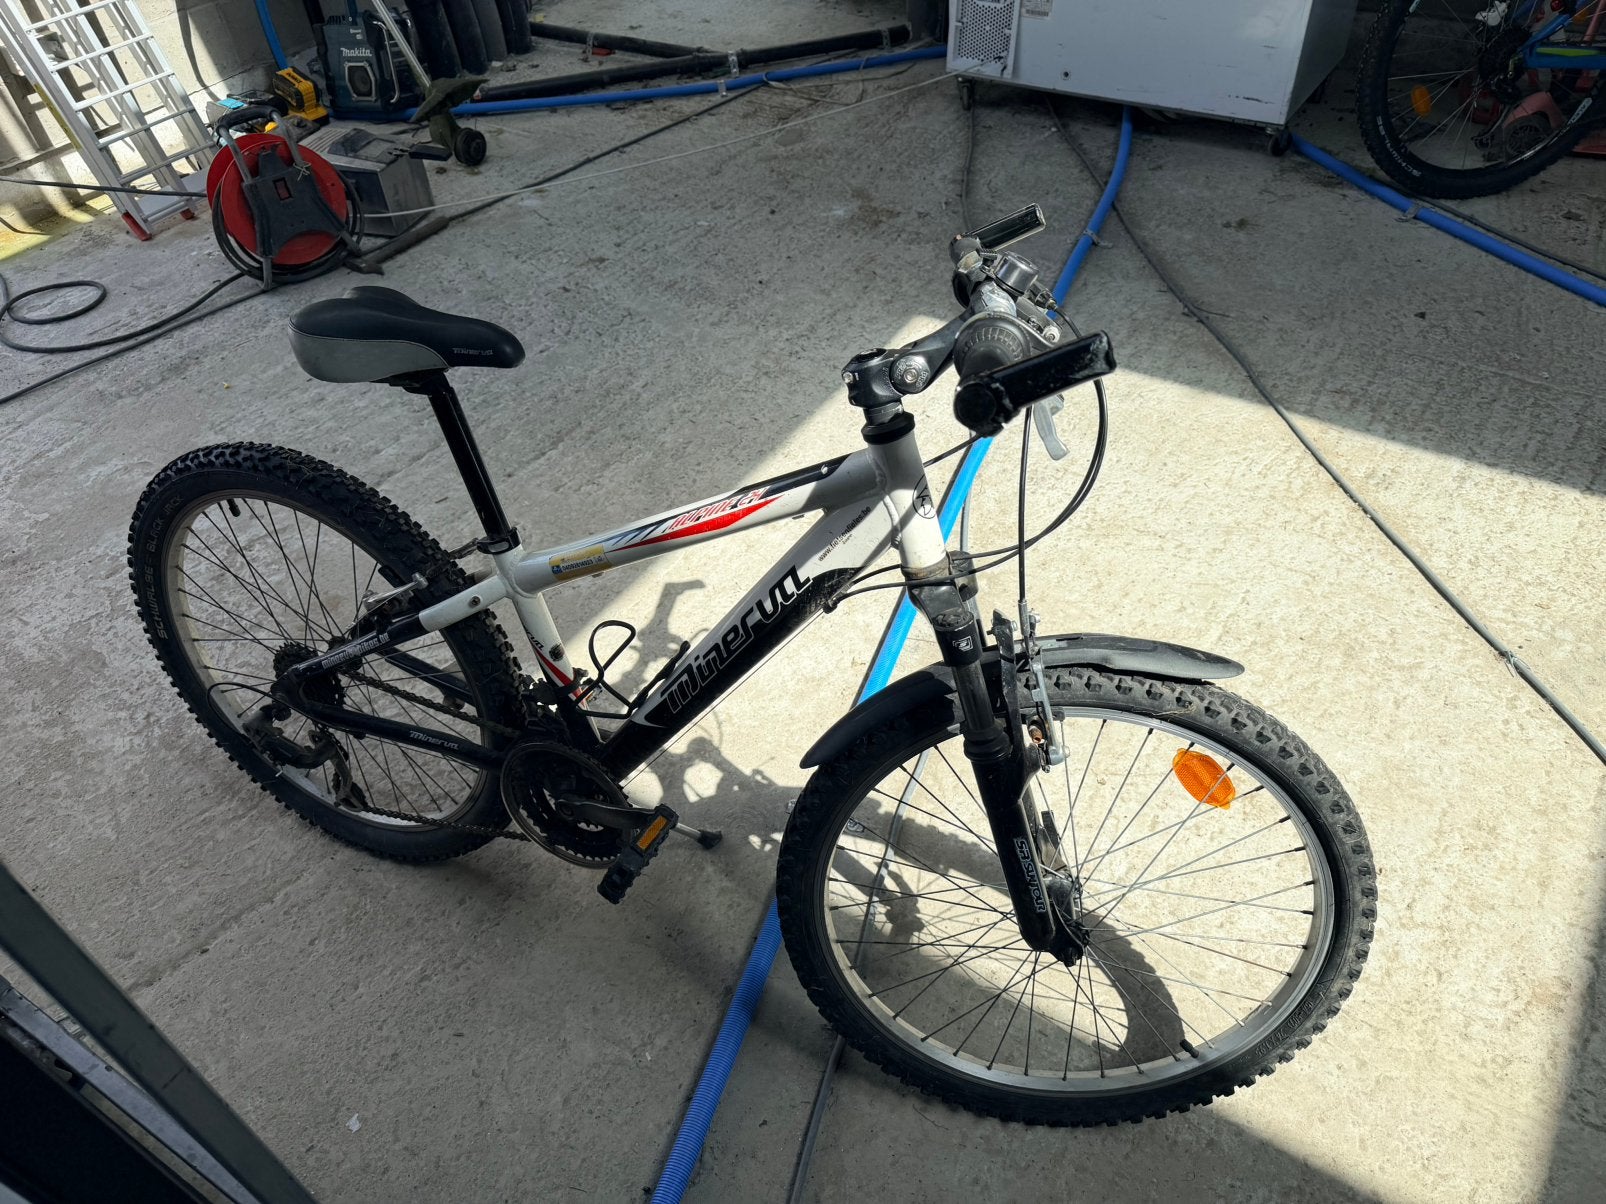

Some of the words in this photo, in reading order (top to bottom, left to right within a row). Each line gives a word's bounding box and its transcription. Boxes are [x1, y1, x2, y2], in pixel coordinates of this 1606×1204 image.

[1376, 115, 1422, 178] SCHWALBE
[164, 494, 185, 517] JACK
[147, 519, 165, 553] BLACK
[145, 565, 169, 640] SCHWALBE
[1014, 838, 1032, 862] SR
[1021, 861, 1047, 913] SUNTOUR
